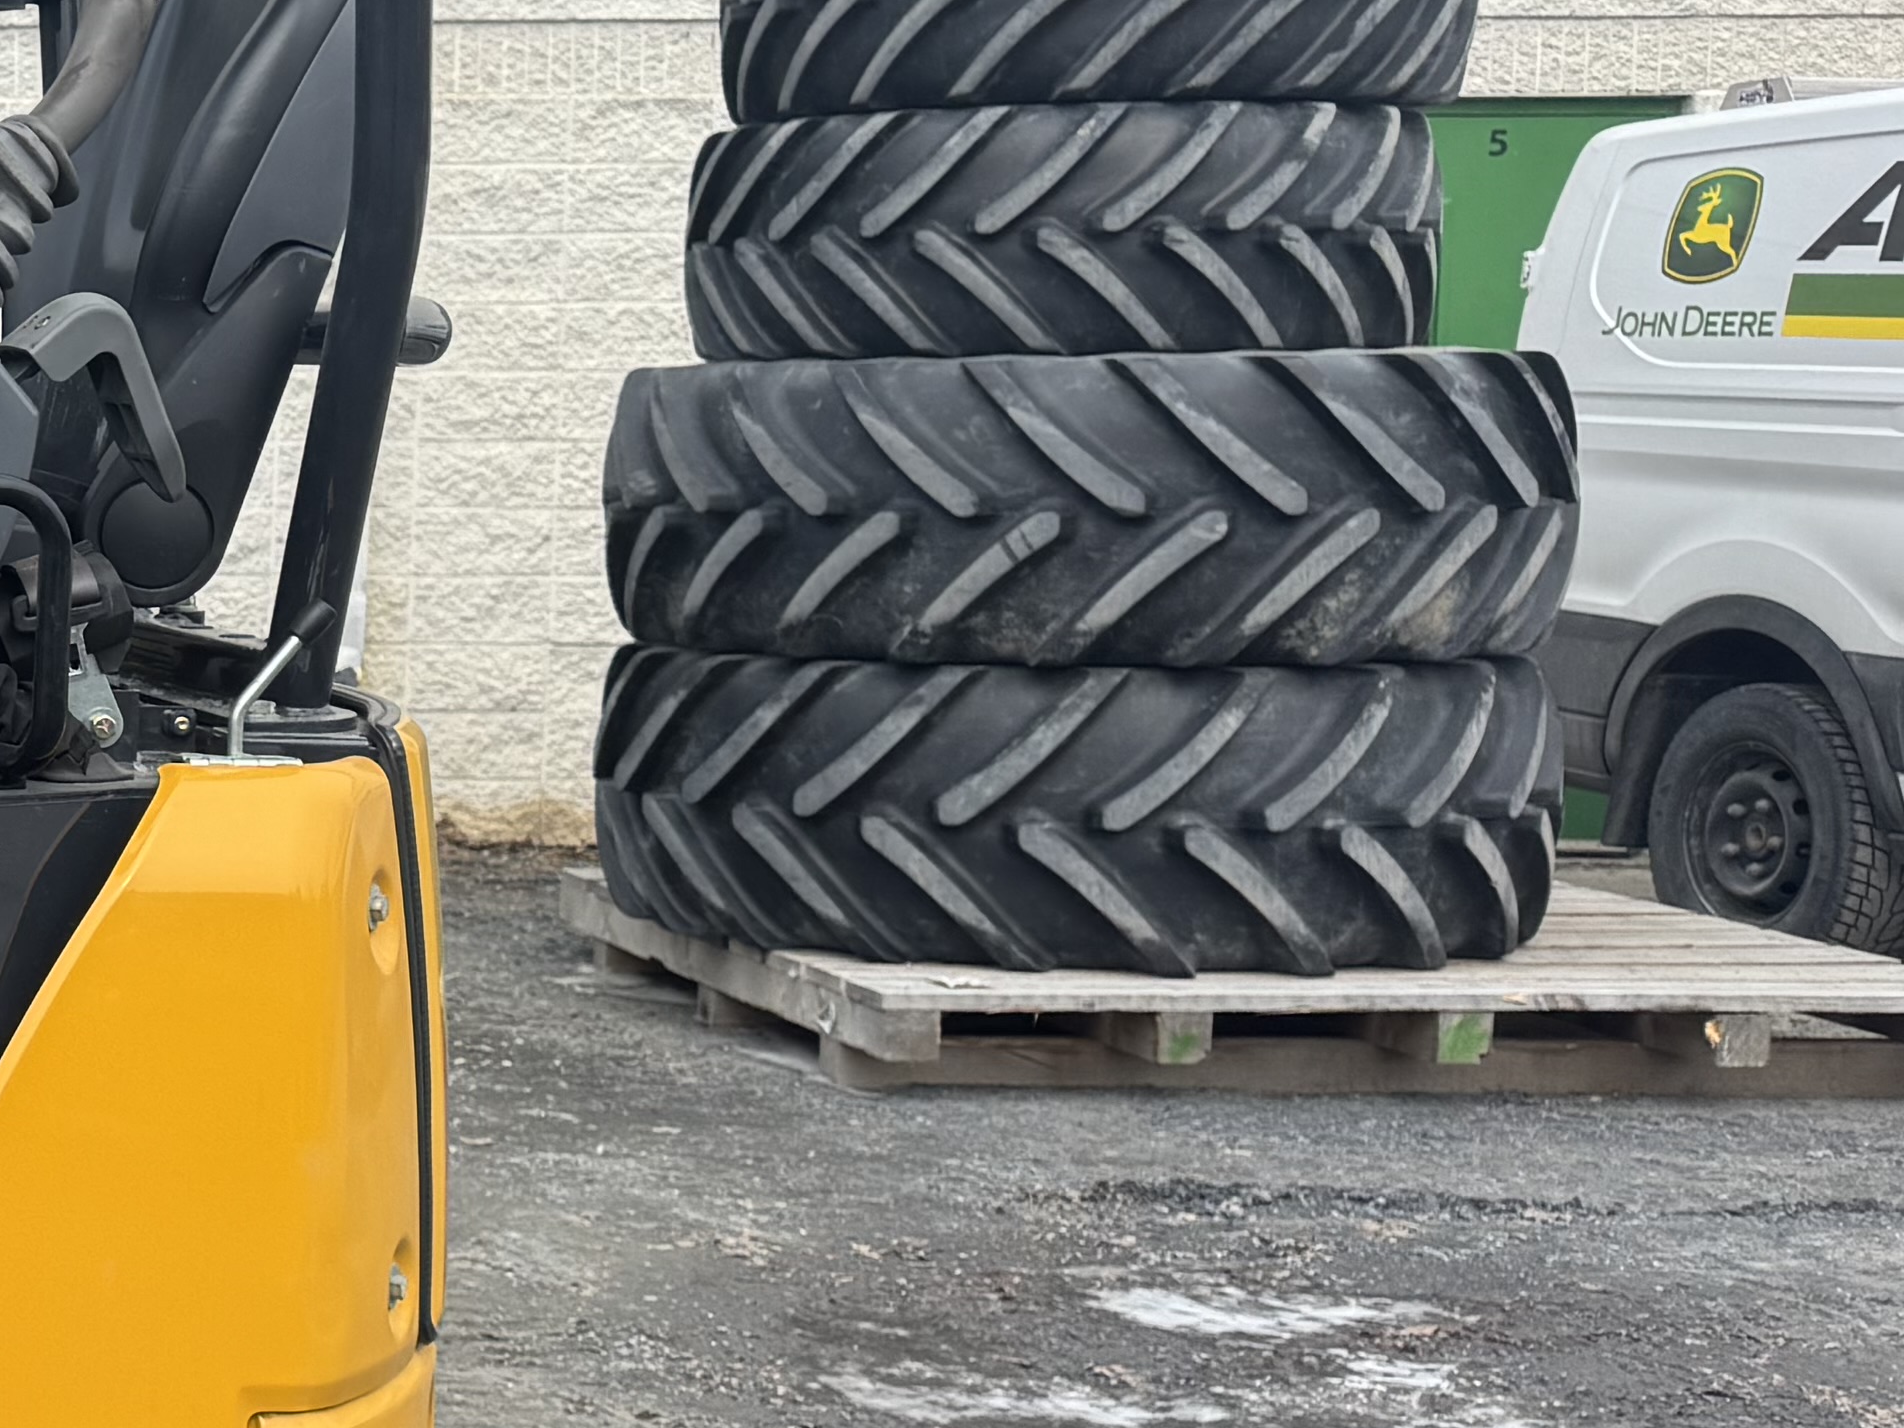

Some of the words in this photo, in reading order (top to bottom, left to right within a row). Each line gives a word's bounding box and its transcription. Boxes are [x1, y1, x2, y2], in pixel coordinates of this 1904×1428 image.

[1488, 129, 1508, 157] 5
[1602, 305, 1678, 338] JOHN
[1681, 305, 1777, 338] DEERE
